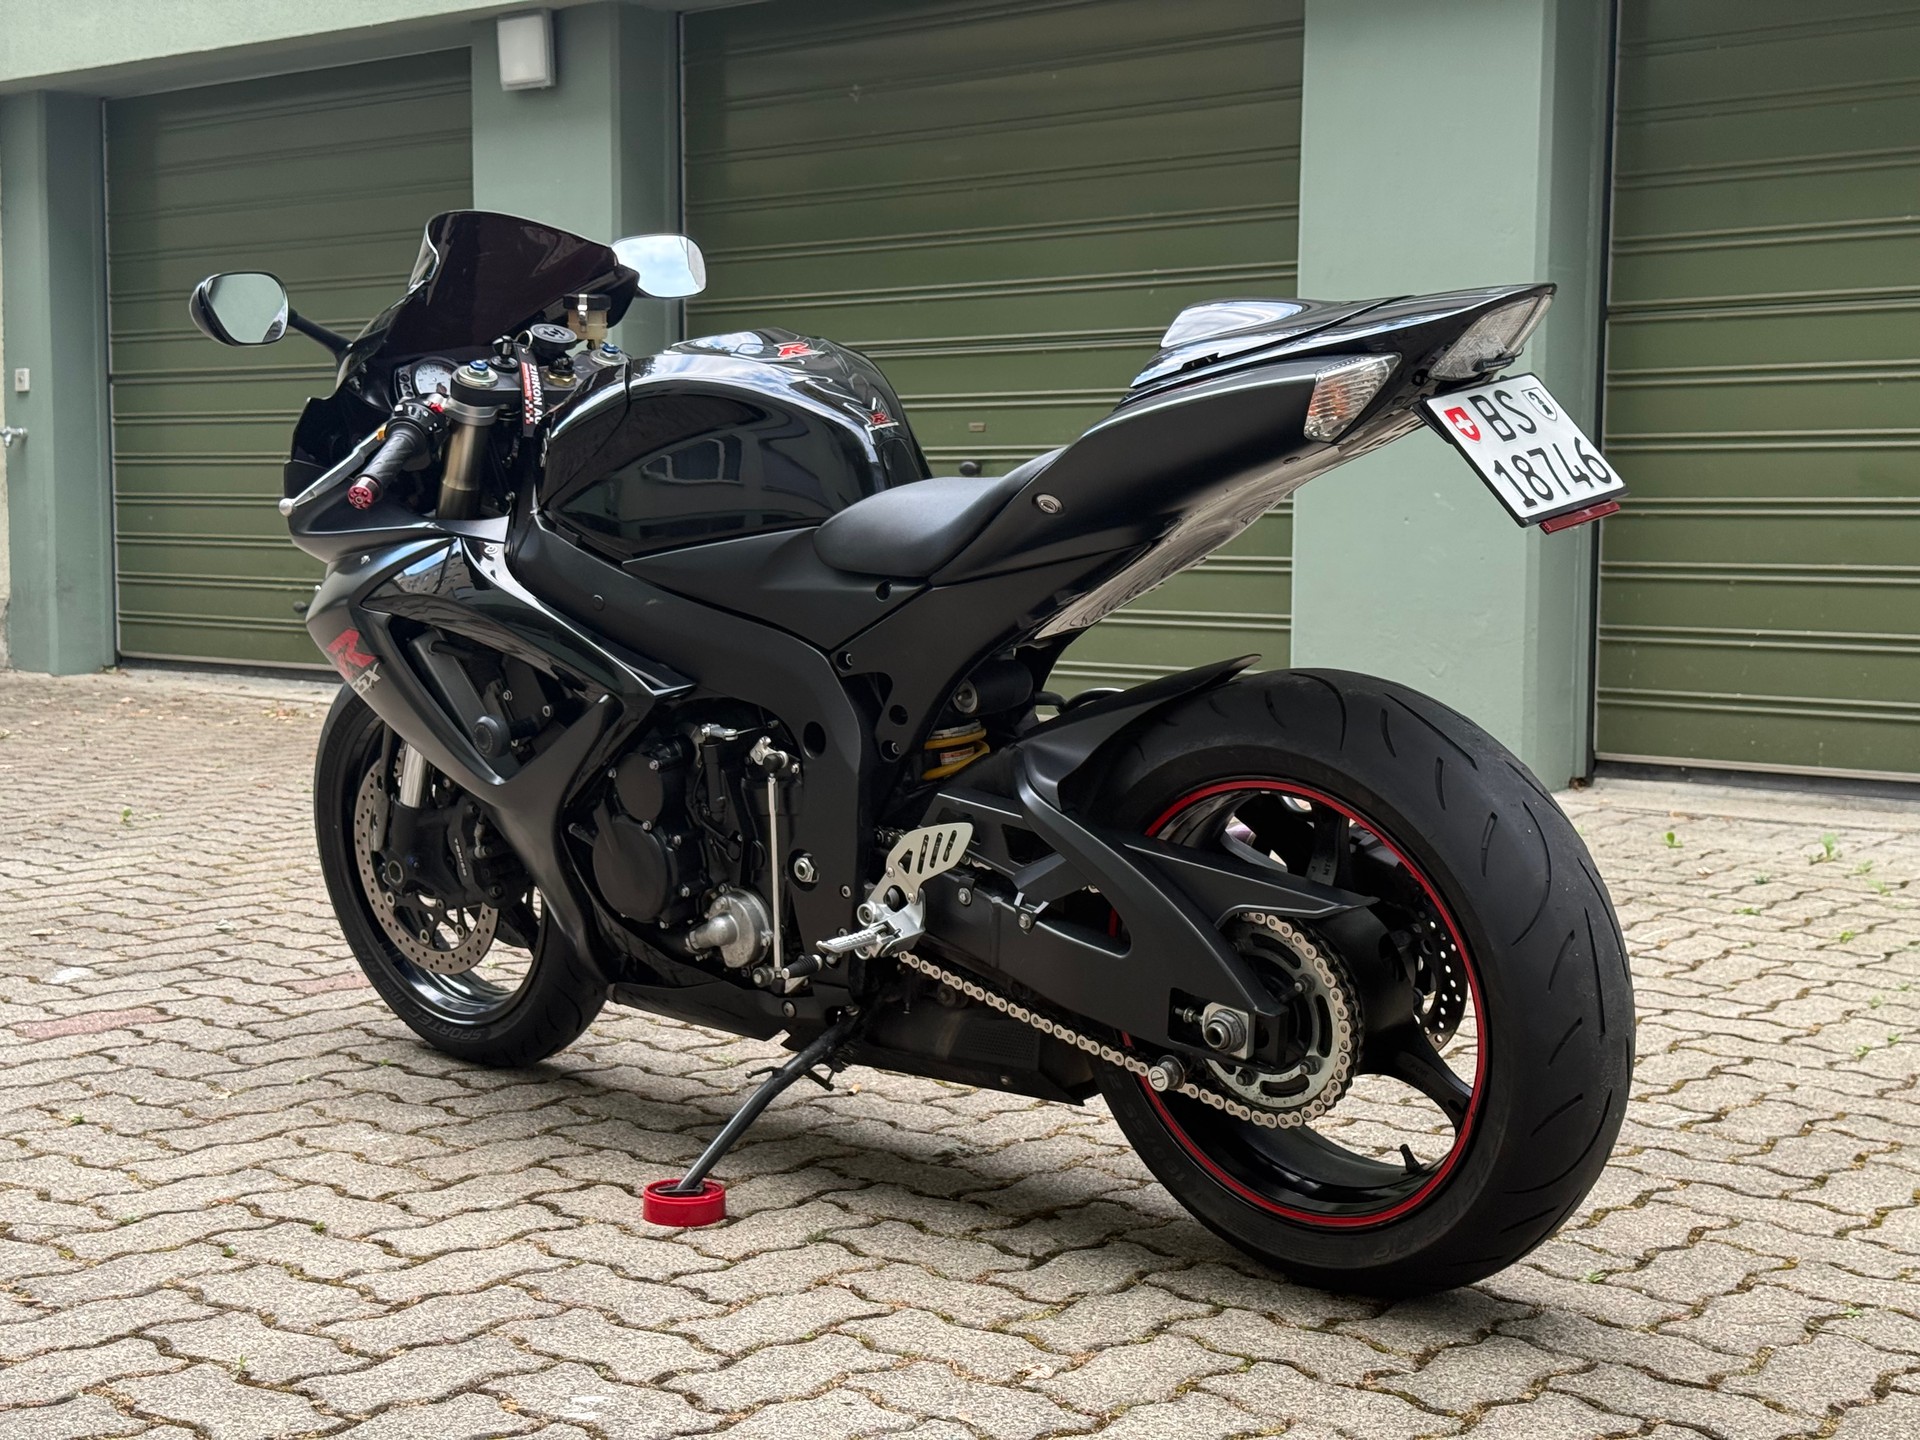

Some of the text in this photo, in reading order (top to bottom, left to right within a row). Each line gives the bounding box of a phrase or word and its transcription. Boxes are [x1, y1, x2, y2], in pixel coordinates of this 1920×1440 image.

[1467, 389, 1537, 442] BS
[1494, 437, 1612, 508] 18746
[327, 628, 378, 680] R
[406, 1003, 485, 1041] SPORTEC
